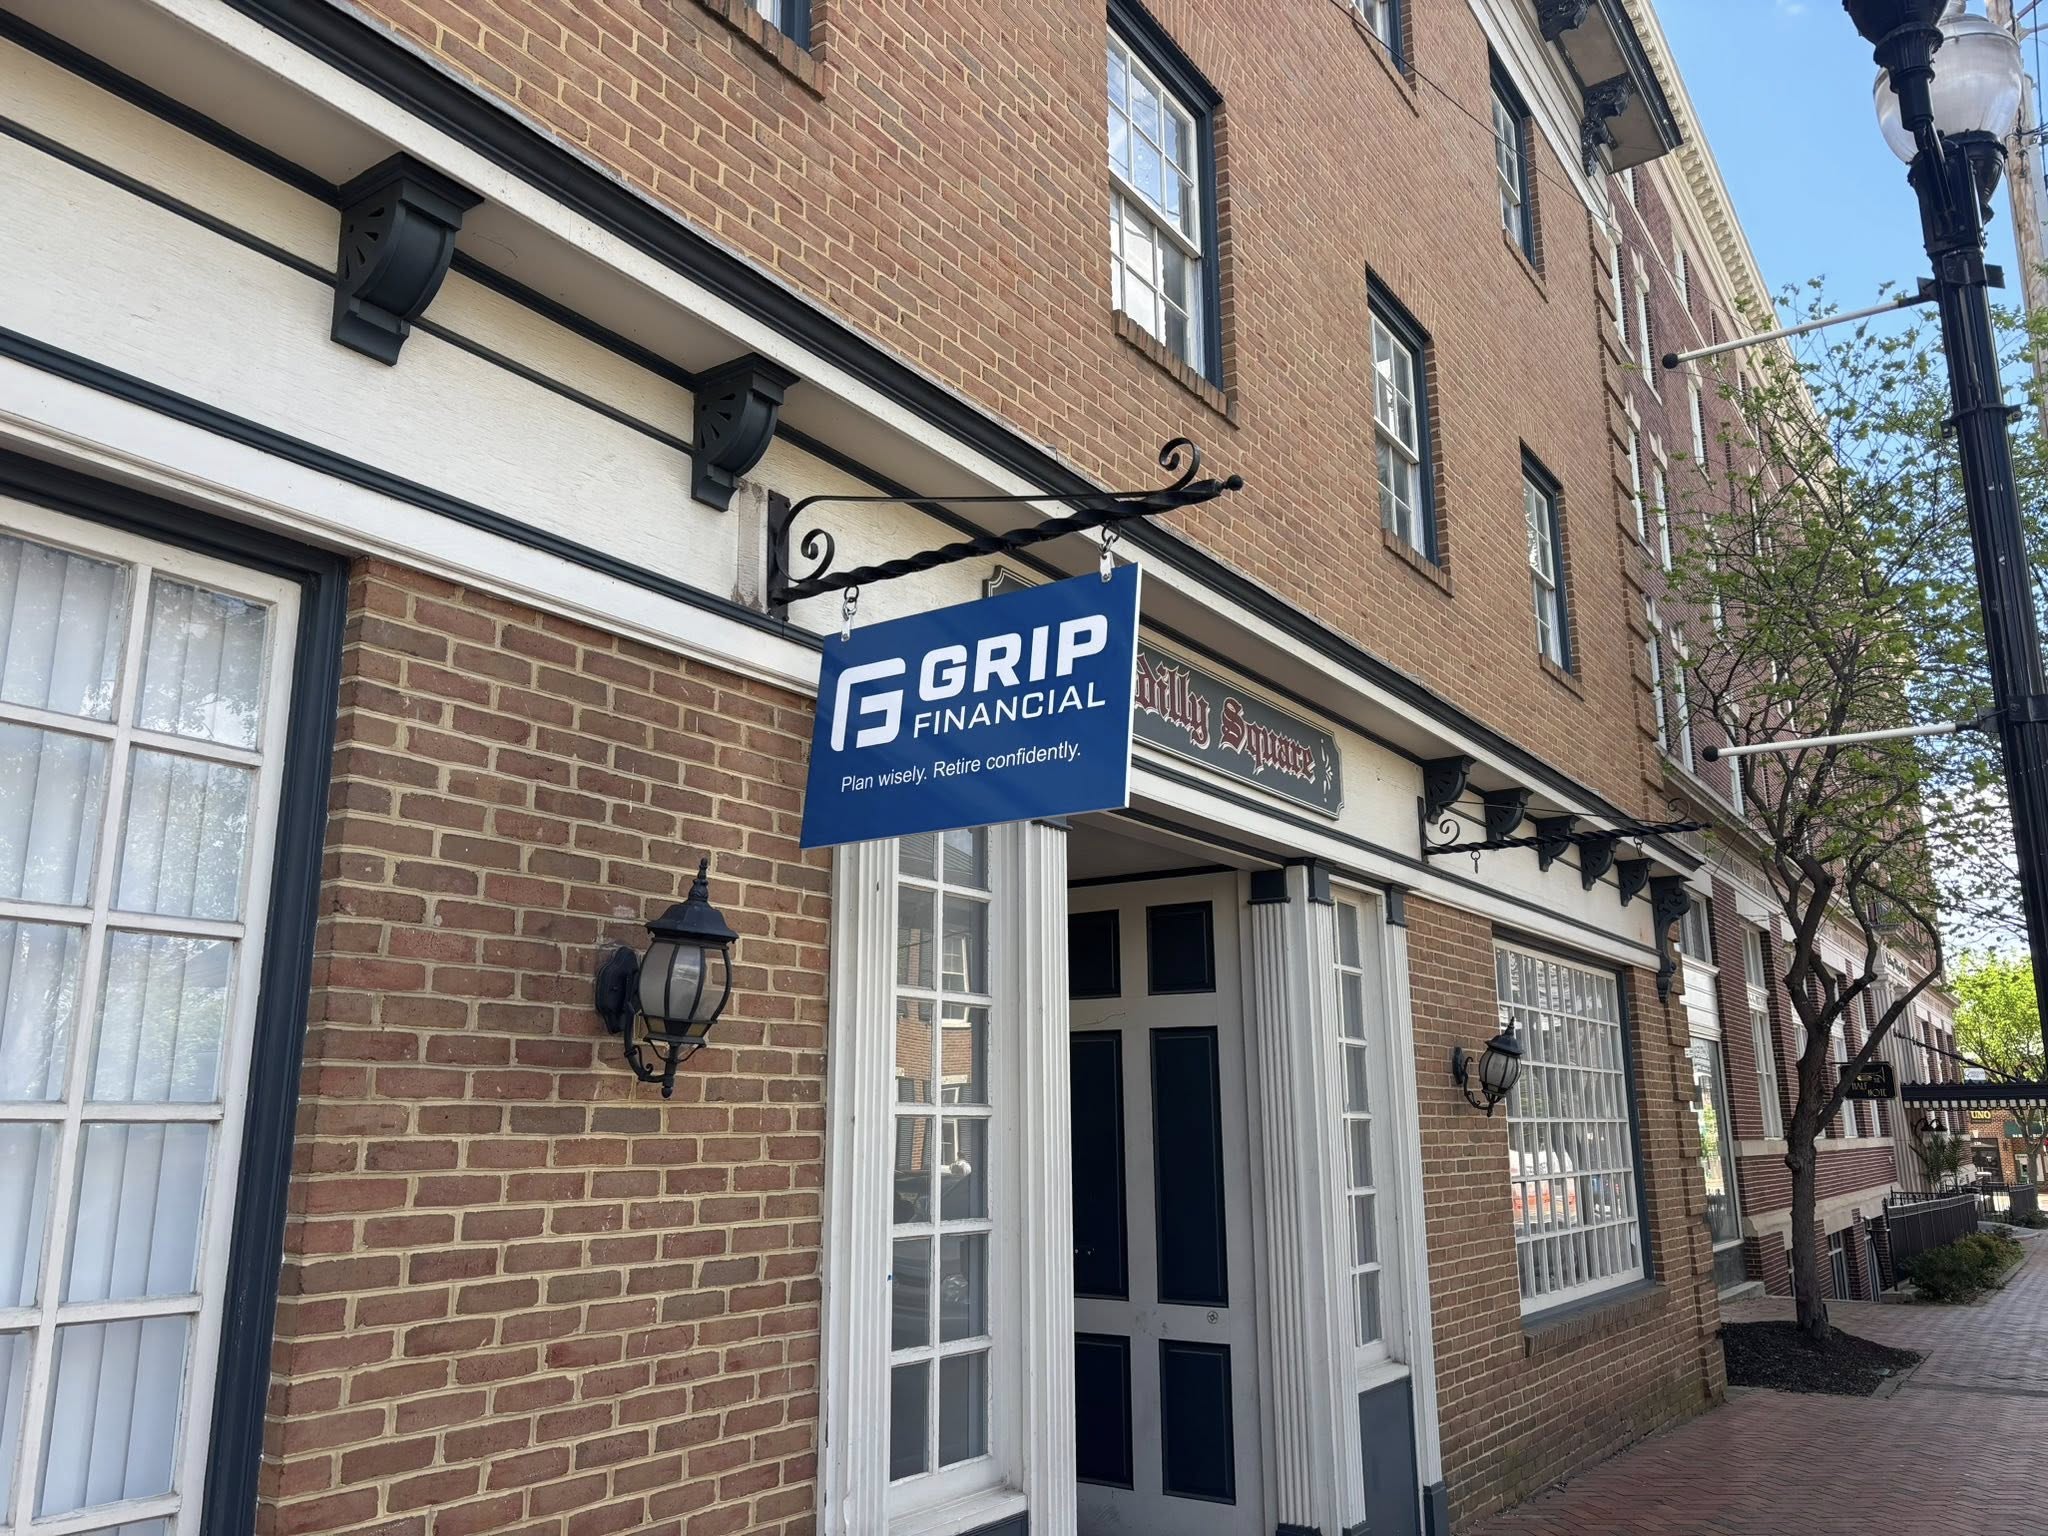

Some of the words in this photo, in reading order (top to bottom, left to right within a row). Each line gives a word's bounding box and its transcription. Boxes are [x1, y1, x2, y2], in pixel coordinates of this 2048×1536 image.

[918, 614, 1108, 701] GRIP
[913, 682, 1106, 738] FINANCIAL
[841, 775, 873, 792] Plan
[878, 765, 927, 787] wisely.
[933, 757, 981, 778] Retire
[986, 740, 1081, 770] confidently.
[1218, 696, 1316, 784] Square
[1970, 1110, 1992, 1119] UNO
